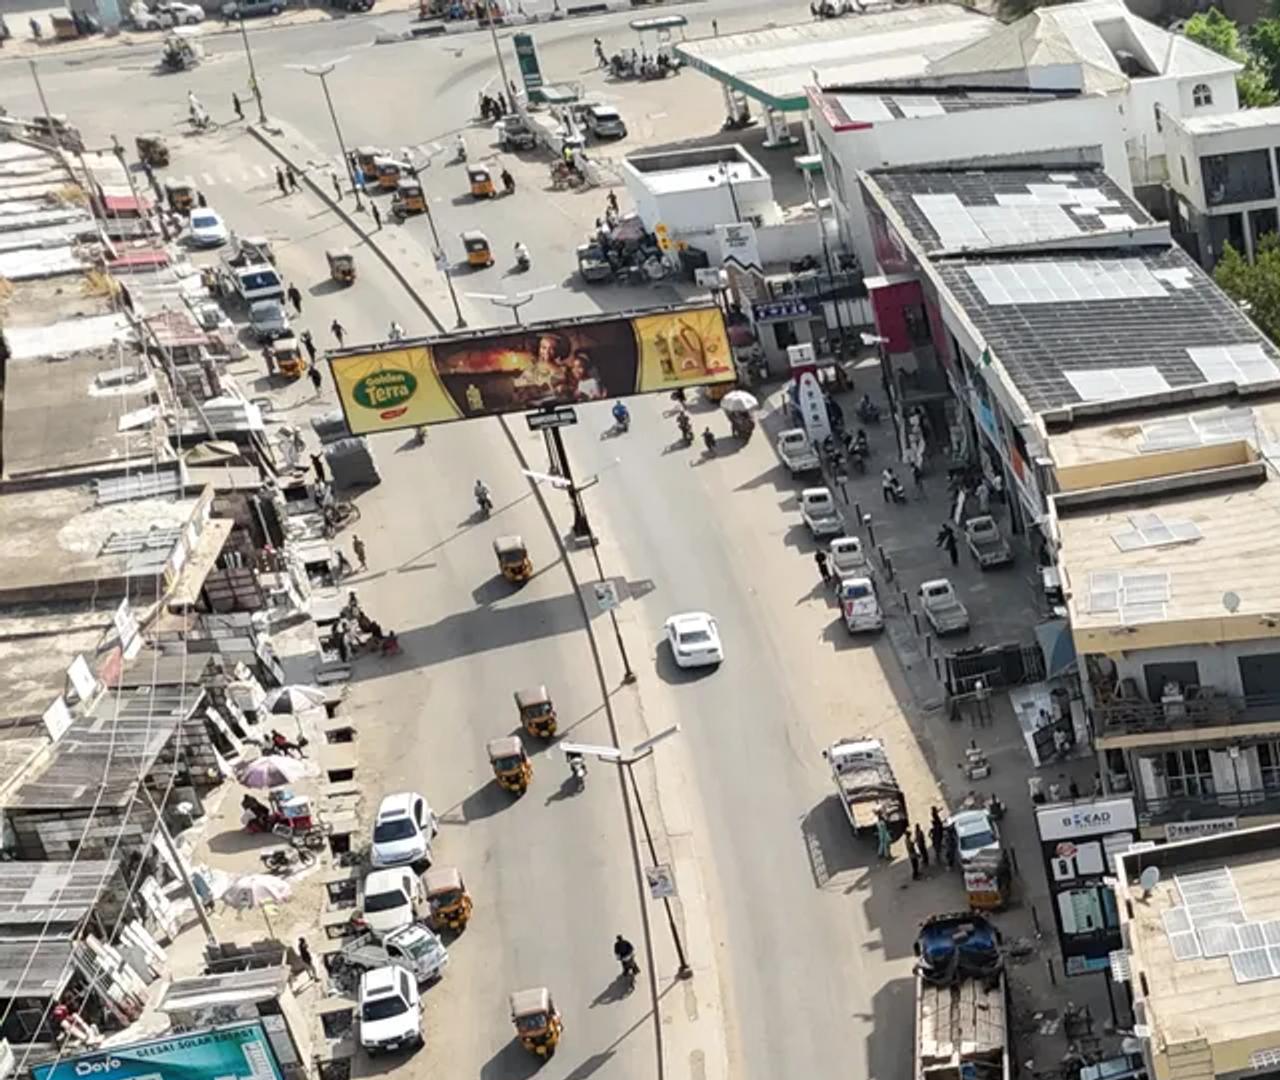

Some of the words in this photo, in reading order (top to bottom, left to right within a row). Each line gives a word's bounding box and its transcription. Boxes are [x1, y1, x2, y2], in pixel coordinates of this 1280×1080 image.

[364, 373, 406, 387] Golden
[365, 385, 410, 406] Terra
[178, 1036, 211, 1050] SOLAR
